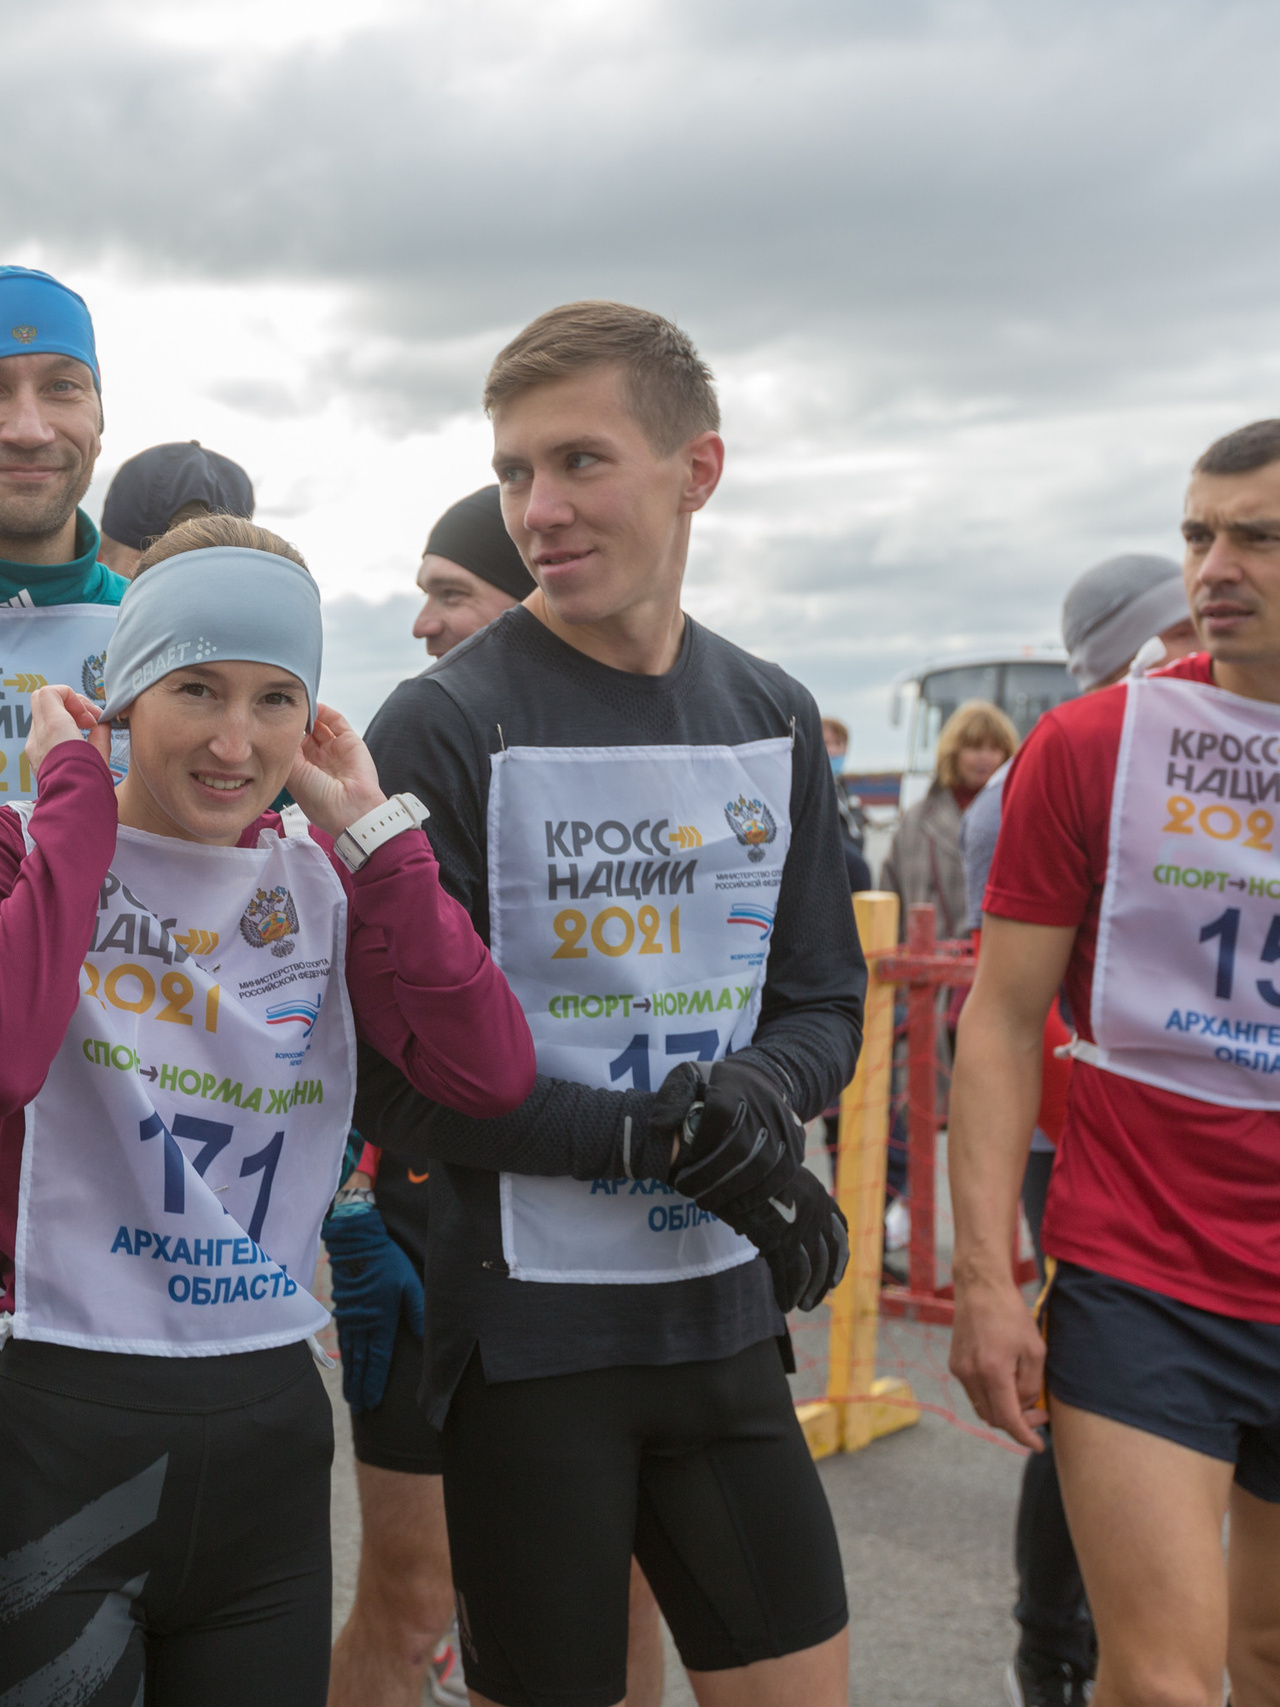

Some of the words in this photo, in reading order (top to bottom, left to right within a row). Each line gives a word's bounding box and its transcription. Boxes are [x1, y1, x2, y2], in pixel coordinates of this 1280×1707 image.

[1169, 727, 1279, 766] КРОСС
[545, 818, 671, 857] КРОСС
[547, 859, 698, 900] НАЦИИ
[1153, 864, 1230, 892] СПОРТ
[550, 904, 681, 959] 2021
[238, 975, 297, 999] РОССИЙСКОЙ
[239, 962, 305, 990] МИНИСТЕРСТВО
[549, 995, 634, 1019] СПОРТ
[652, 986, 731, 1016] НОРМА
[609, 1029, 732, 1093] 17
[159, 1063, 263, 1115] НОРМА
[264, 1079, 324, 1115] ЖНИ
[139, 1110, 285, 1243] 171
[110, 1225, 272, 1266] АРХАНГЕЛ
[168, 1271, 297, 1305] ОБЛАСТЬ
